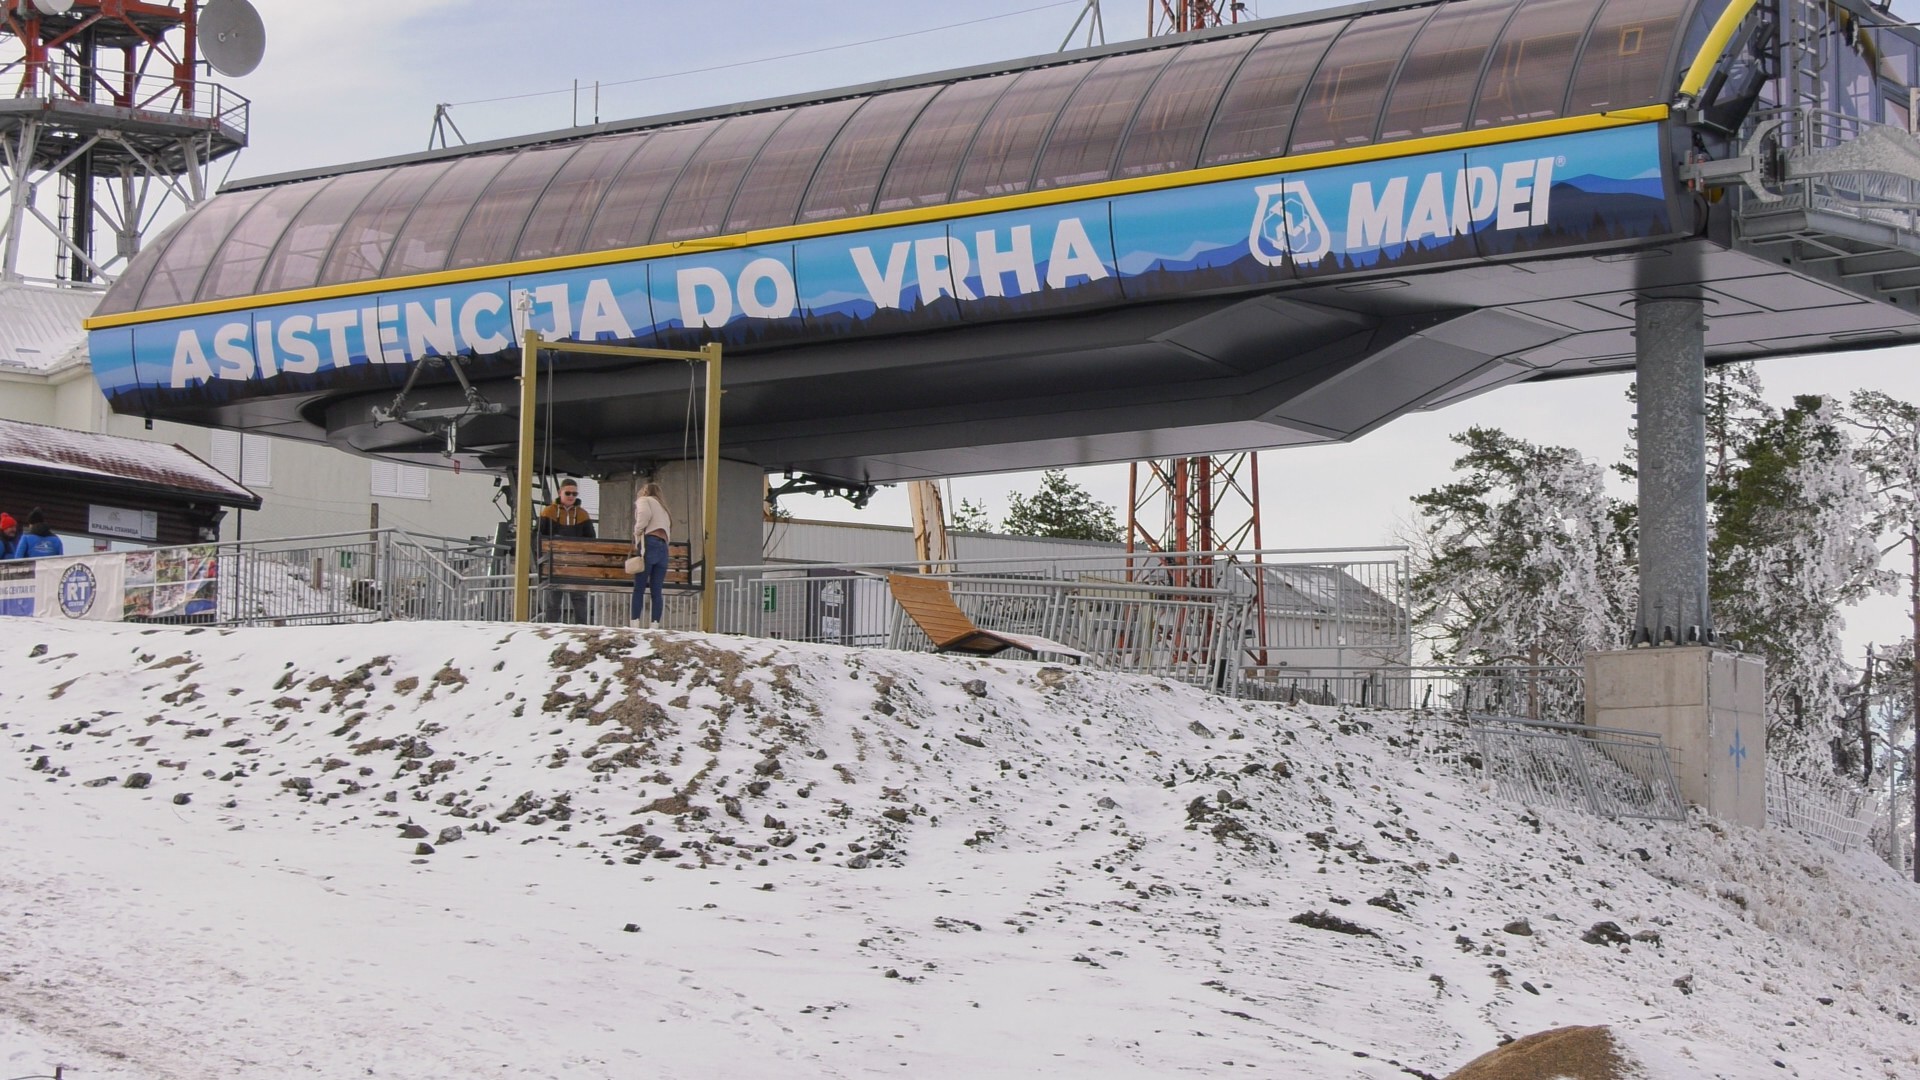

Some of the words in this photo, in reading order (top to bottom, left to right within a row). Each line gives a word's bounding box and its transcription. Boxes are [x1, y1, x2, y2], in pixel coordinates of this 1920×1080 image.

[1345, 156, 1554, 249] MAPEI
[169, 278, 636, 388] ASISTENCIJA
[676, 257, 796, 329] DO
[849, 217, 1109, 306] VRHA
[66, 582, 89, 601] RT
